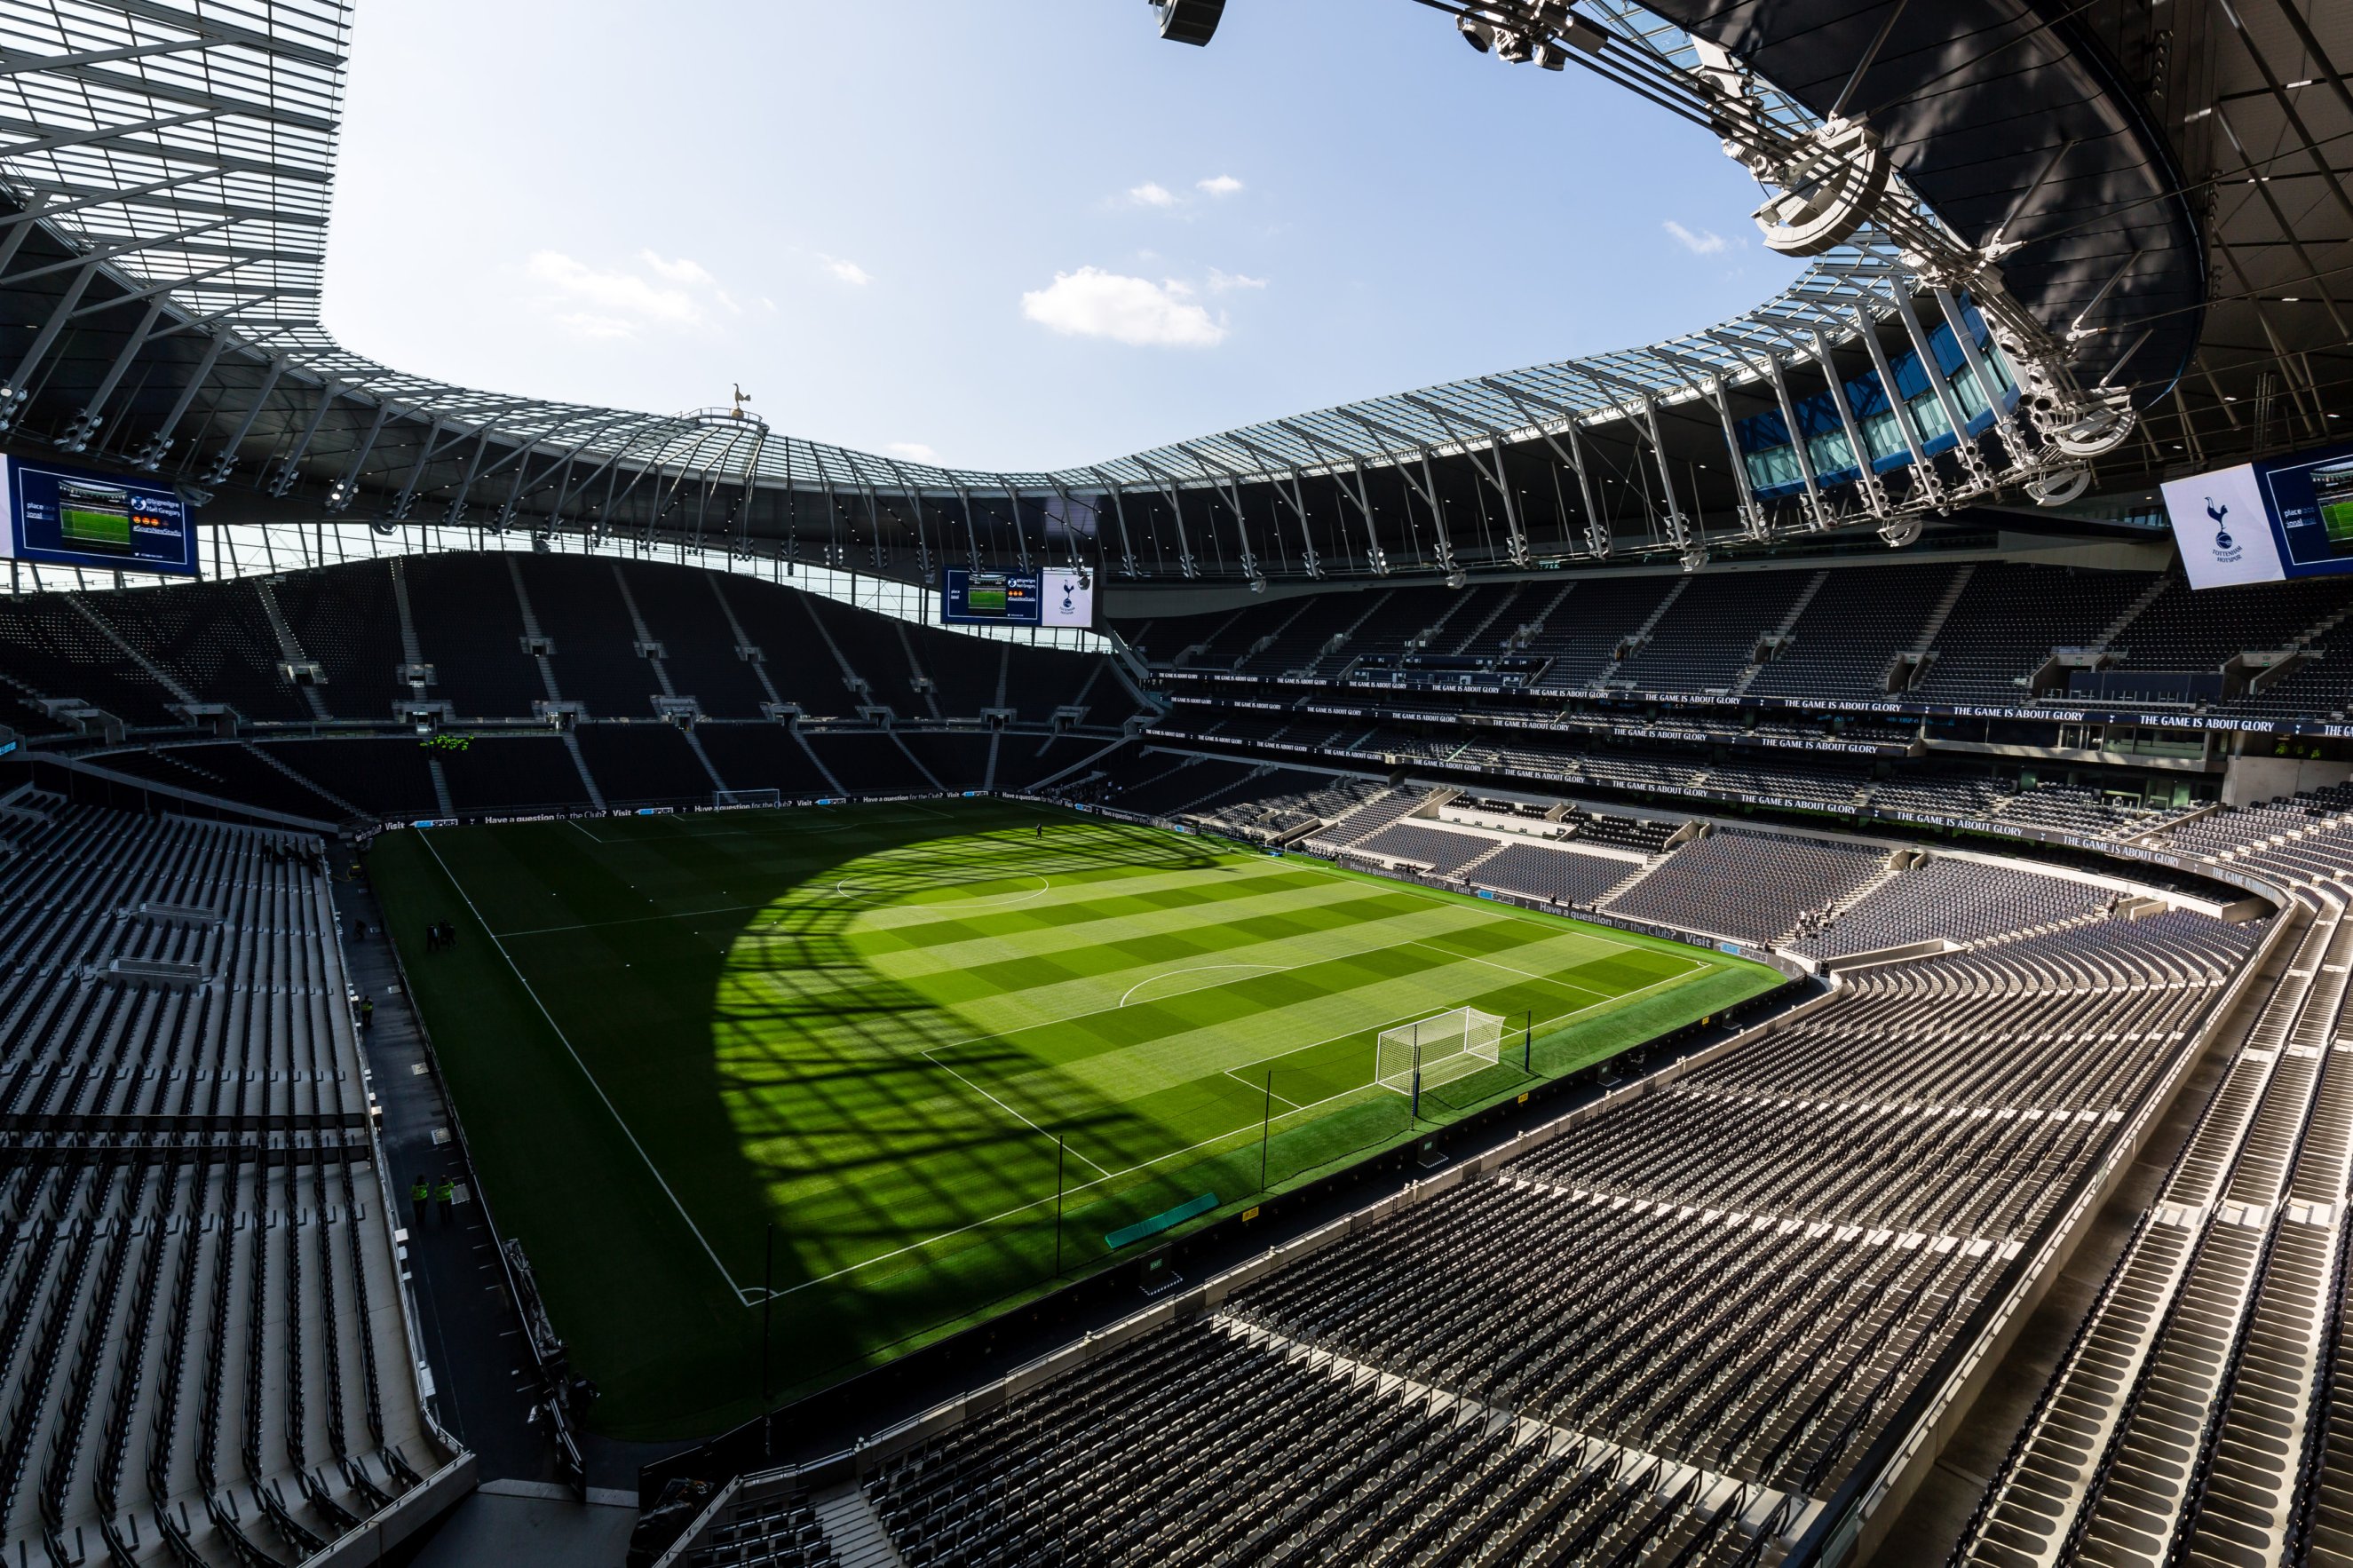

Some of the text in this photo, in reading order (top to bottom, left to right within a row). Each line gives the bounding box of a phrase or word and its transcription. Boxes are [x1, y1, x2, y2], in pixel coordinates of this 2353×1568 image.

[159, 508, 180, 517] Gregory
[2284, 509, 2302, 518] place
[2213, 546, 2243, 557] TOTTENHAM
[2217, 554, 2243, 563] HOTSPUR
[1872, 703, 1902, 712] GLORY
[1953, 707, 1972, 716] THE
[1975, 708, 2001, 717] GAME
[2016, 709, 2050, 719] ABOUT
[2053, 711, 2084, 721] GLORY
[2140, 716, 2274, 732] THE GAME IS ABOUT GLORY
[2325, 725, 2342, 736] THE
[1779, 740, 1803, 748] GAME
[1816, 742, 1846, 751] ABOUT
[1849, 744, 1878, 753] GLORY
[1612, 780, 1625, 789] THE
[1627, 782, 1646, 791] GAME
[1657, 785, 1682, 795] ABOUT
[1684, 788, 1707, 797] GLORY
[1741, 795, 1857, 814] THE GAME IS ABOUT GLORY
[385, 822, 405, 831] Visit
[1897, 812, 2023, 836] THE GAME IS ABOUT GLORY
[2064, 836, 2180, 867] THE GAME IS ABOUT GLORY
[2213, 867, 2223, 879] THE
[2225, 872, 2244, 884] GAME
[1350, 862, 1366, 873] Have
[1372, 868, 1402, 880] question
[1427, 878, 1446, 890] Club?
[1454, 883, 1470, 895] Visit
[1479, 890, 1492, 899] ASK
[1493, 893, 1514, 903] SPURS
[1540, 902, 1561, 915] Have
[1571, 911, 1612, 926] question
[1614, 918, 1628, 928] for
[1630, 923, 1645, 932] the
[1648, 926, 1676, 939] Club?
[1685, 933, 1711, 948] Visit
[1722, 943, 1739, 954] ASK
[1739, 947, 1766, 962] SPURS
[1151, 1260, 1161, 1269] EXIT
